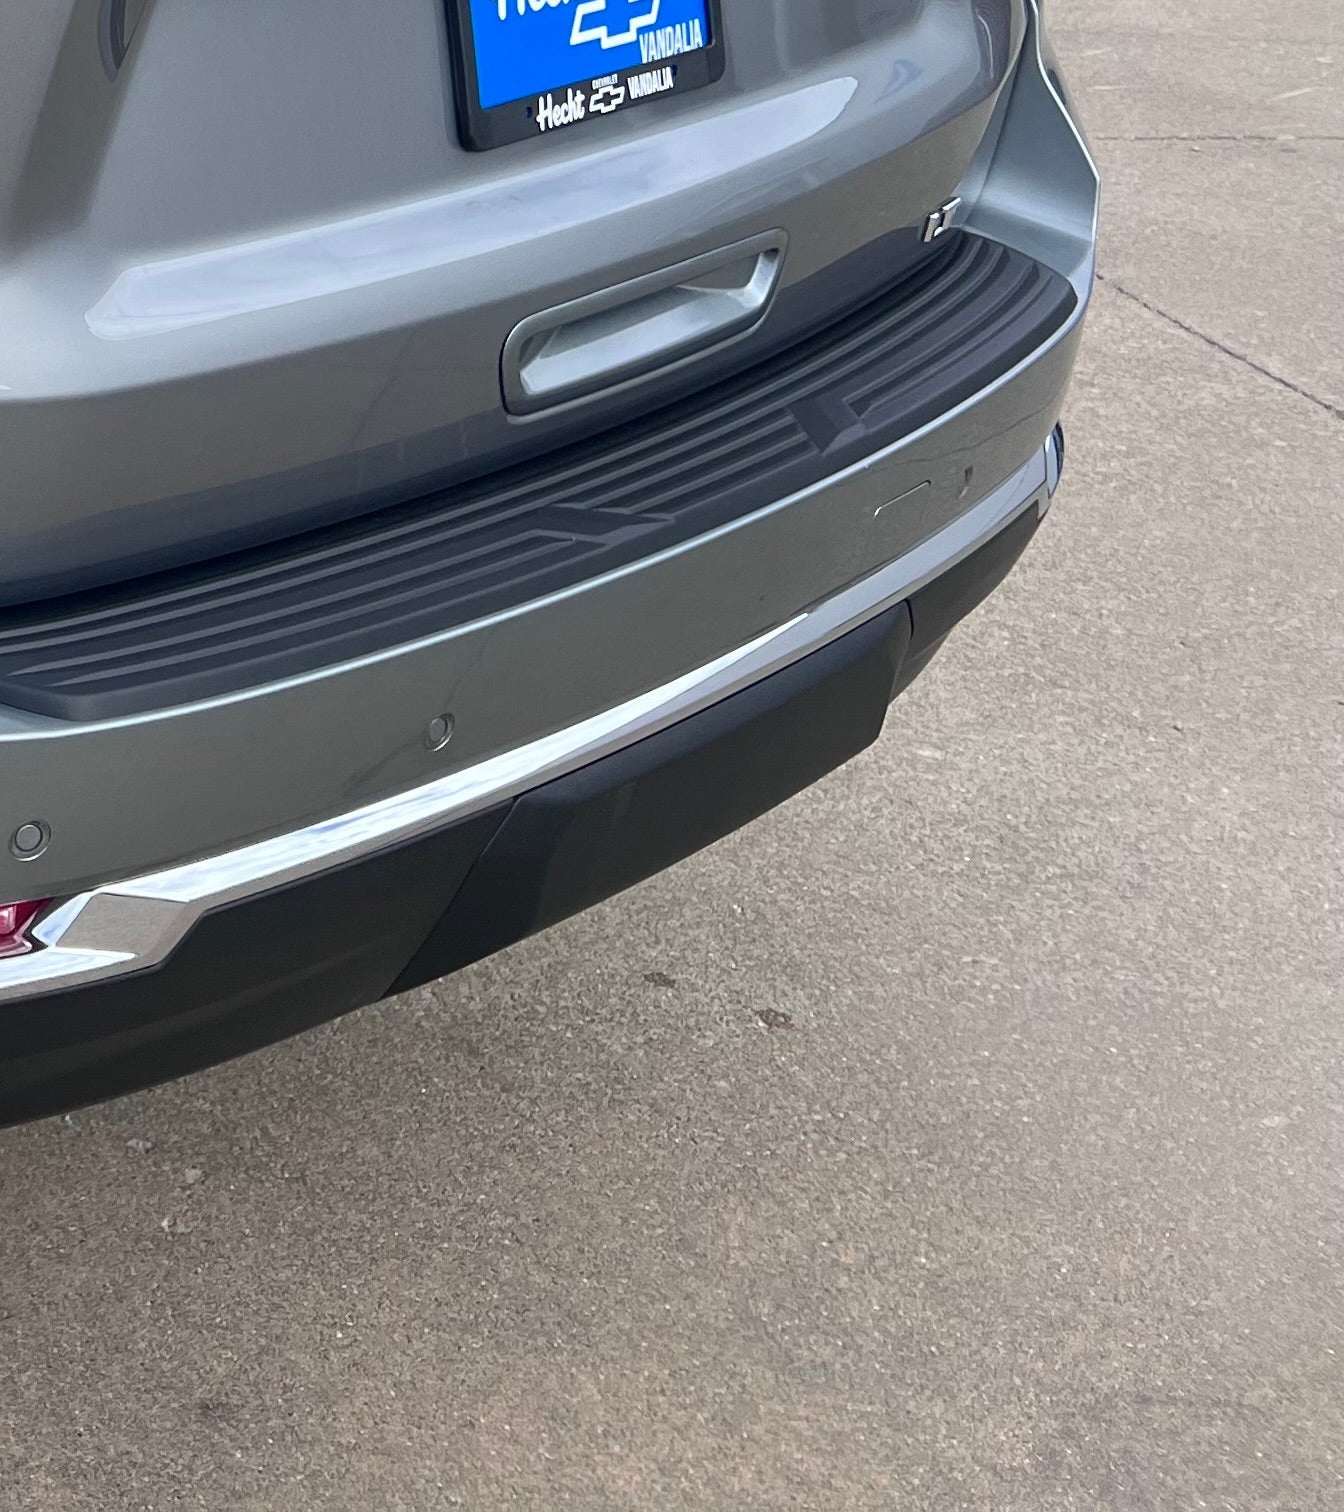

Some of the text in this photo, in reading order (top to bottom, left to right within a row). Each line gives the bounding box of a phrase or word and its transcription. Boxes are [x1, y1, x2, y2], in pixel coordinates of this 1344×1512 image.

[639, 18, 703, 64] VANDALIA
[536, 66, 673, 131] Hecht VANDALIA
